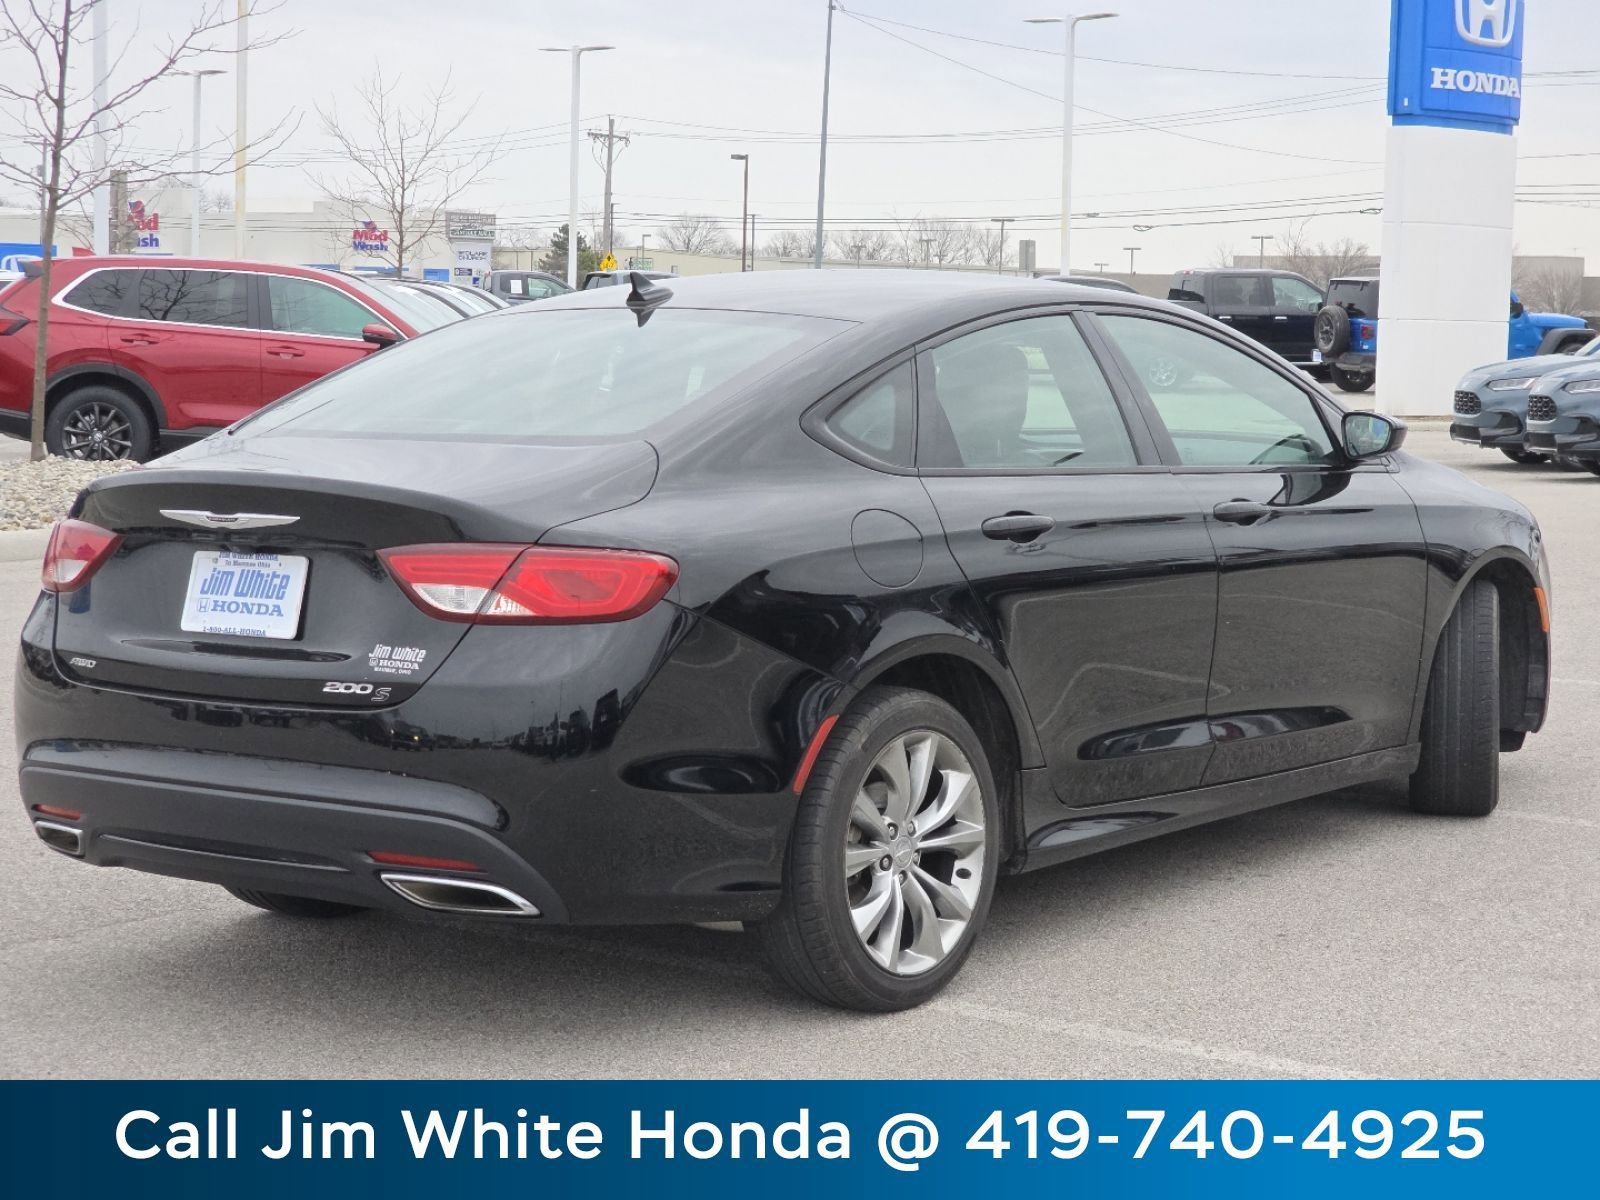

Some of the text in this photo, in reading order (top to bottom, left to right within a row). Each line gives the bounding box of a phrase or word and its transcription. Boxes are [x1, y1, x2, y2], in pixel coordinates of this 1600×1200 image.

[1430, 67, 1520, 98] HONDA
[352, 240, 389, 251] Wash
[234, 568, 290, 600] White
[211, 599, 284, 616] HONDA
[369, 644, 426, 662] Jim White
[379, 660, 419, 670] HONDA
[322, 681, 392, 701] 200 S
